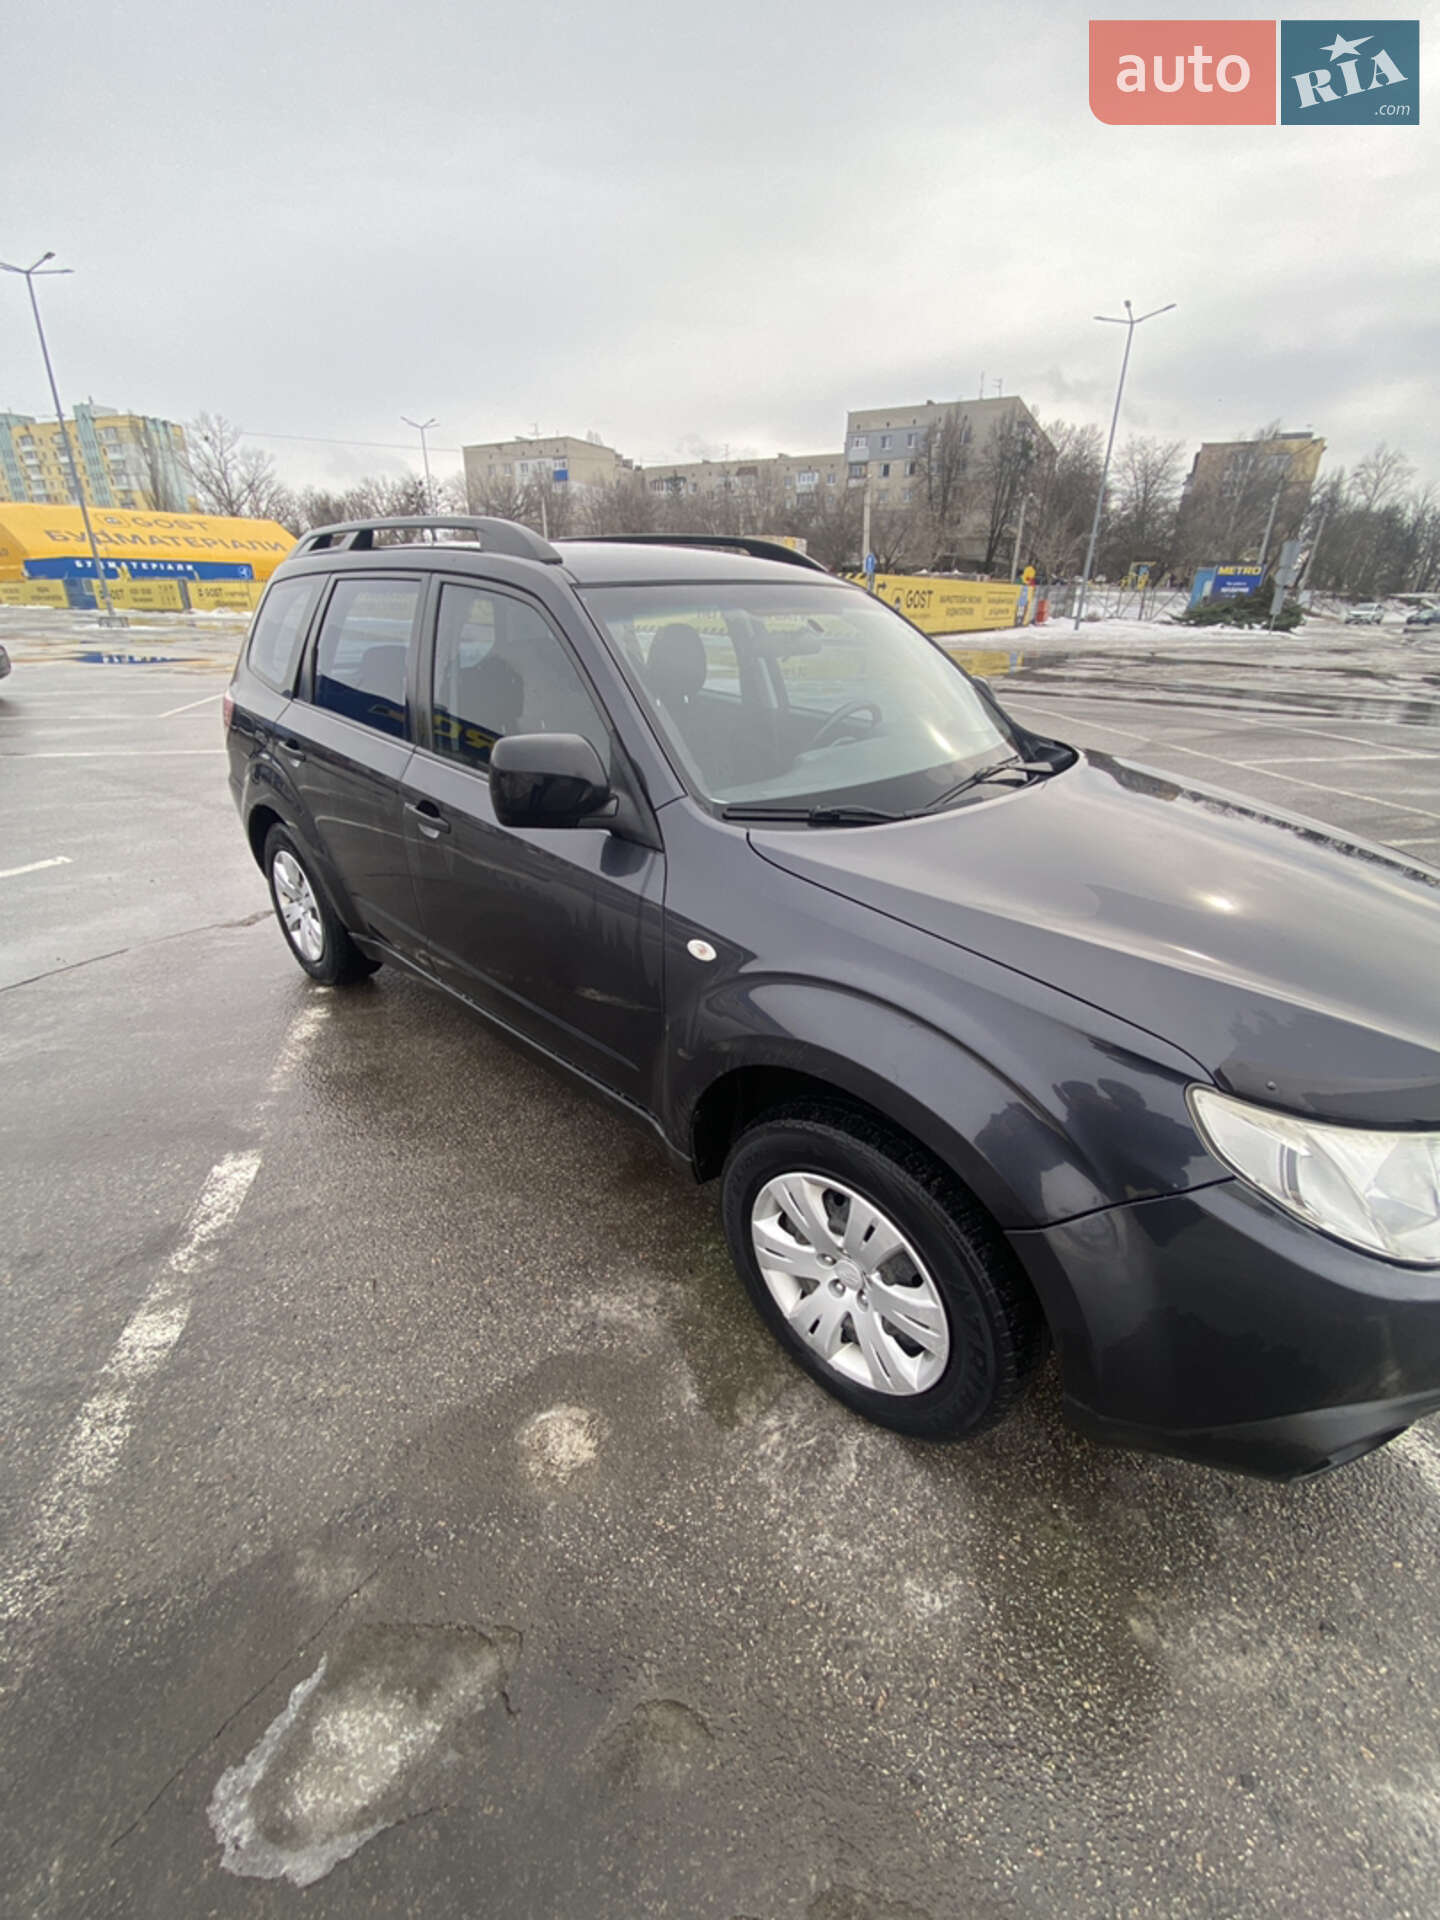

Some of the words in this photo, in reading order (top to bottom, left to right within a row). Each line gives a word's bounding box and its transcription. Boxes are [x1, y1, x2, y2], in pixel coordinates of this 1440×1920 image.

[131, 517, 209, 531] GOST
[1218, 566, 1262, 576] METRO
[906, 590, 933, 609] GOST
